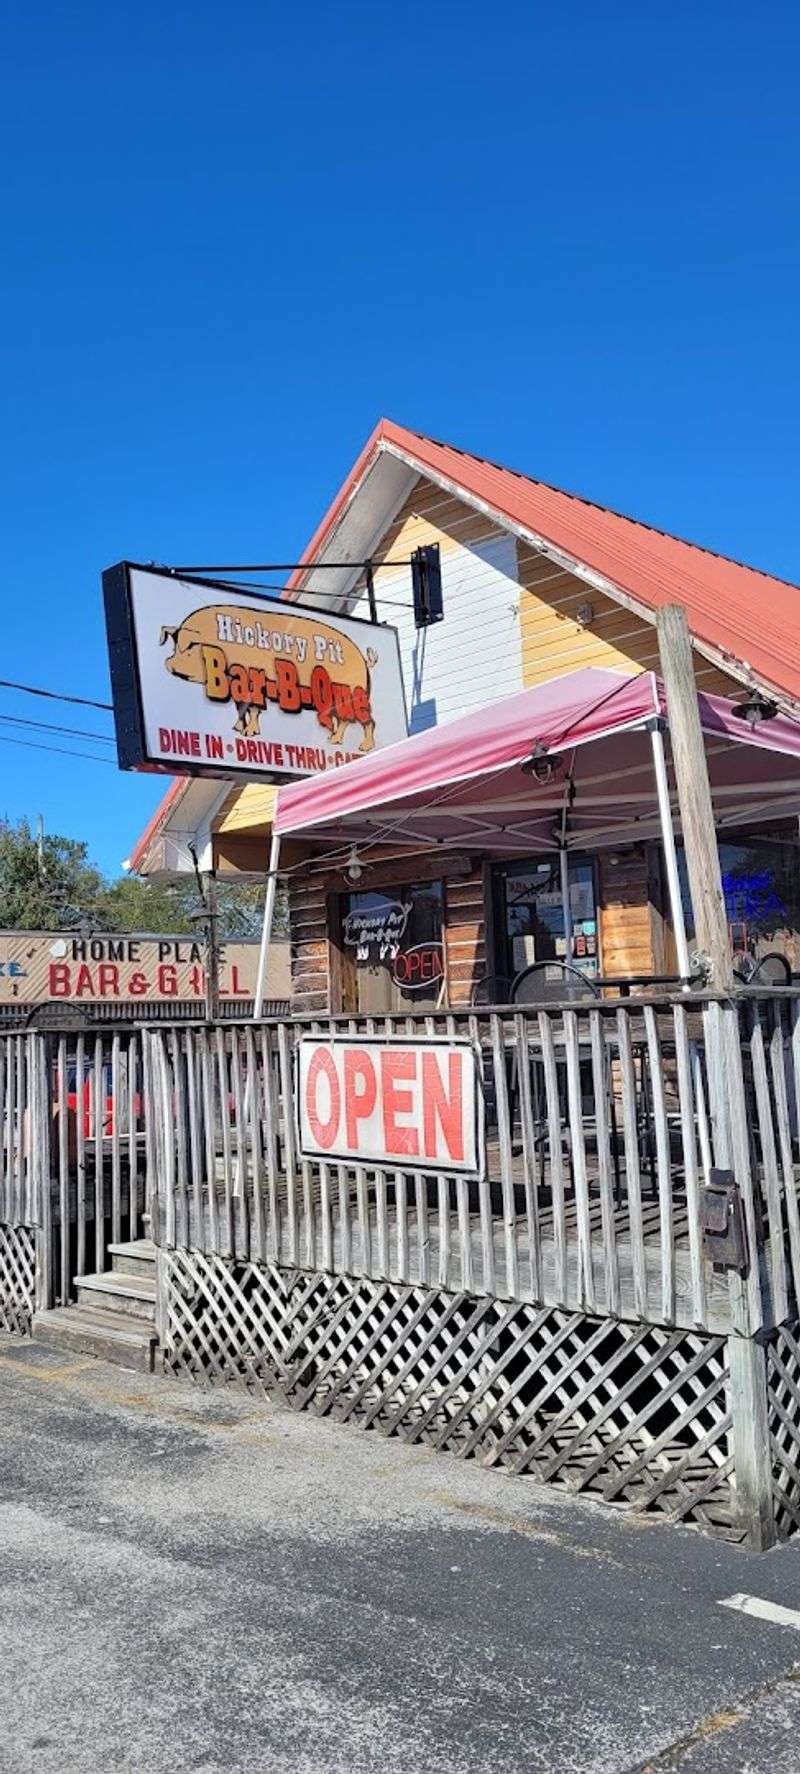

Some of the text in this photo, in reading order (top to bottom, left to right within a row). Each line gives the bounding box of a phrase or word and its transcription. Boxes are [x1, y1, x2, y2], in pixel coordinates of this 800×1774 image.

[216, 613, 345, 664] Hickory Pit
[201, 644, 372, 726] Bar-B-Que
[158, 728, 200, 756] DINE
[205, 734, 224, 759] IN
[235, 738, 284, 766] DRIVE
[285, 744, 326, 771] THRU
[71, 939, 227, 963] HOME PLAE
[394, 950, 443, 981] OPEN
[49, 964, 119, 997] BAR
[128, 972, 151, 996] &
[306, 1046, 465, 1161] OPEN
